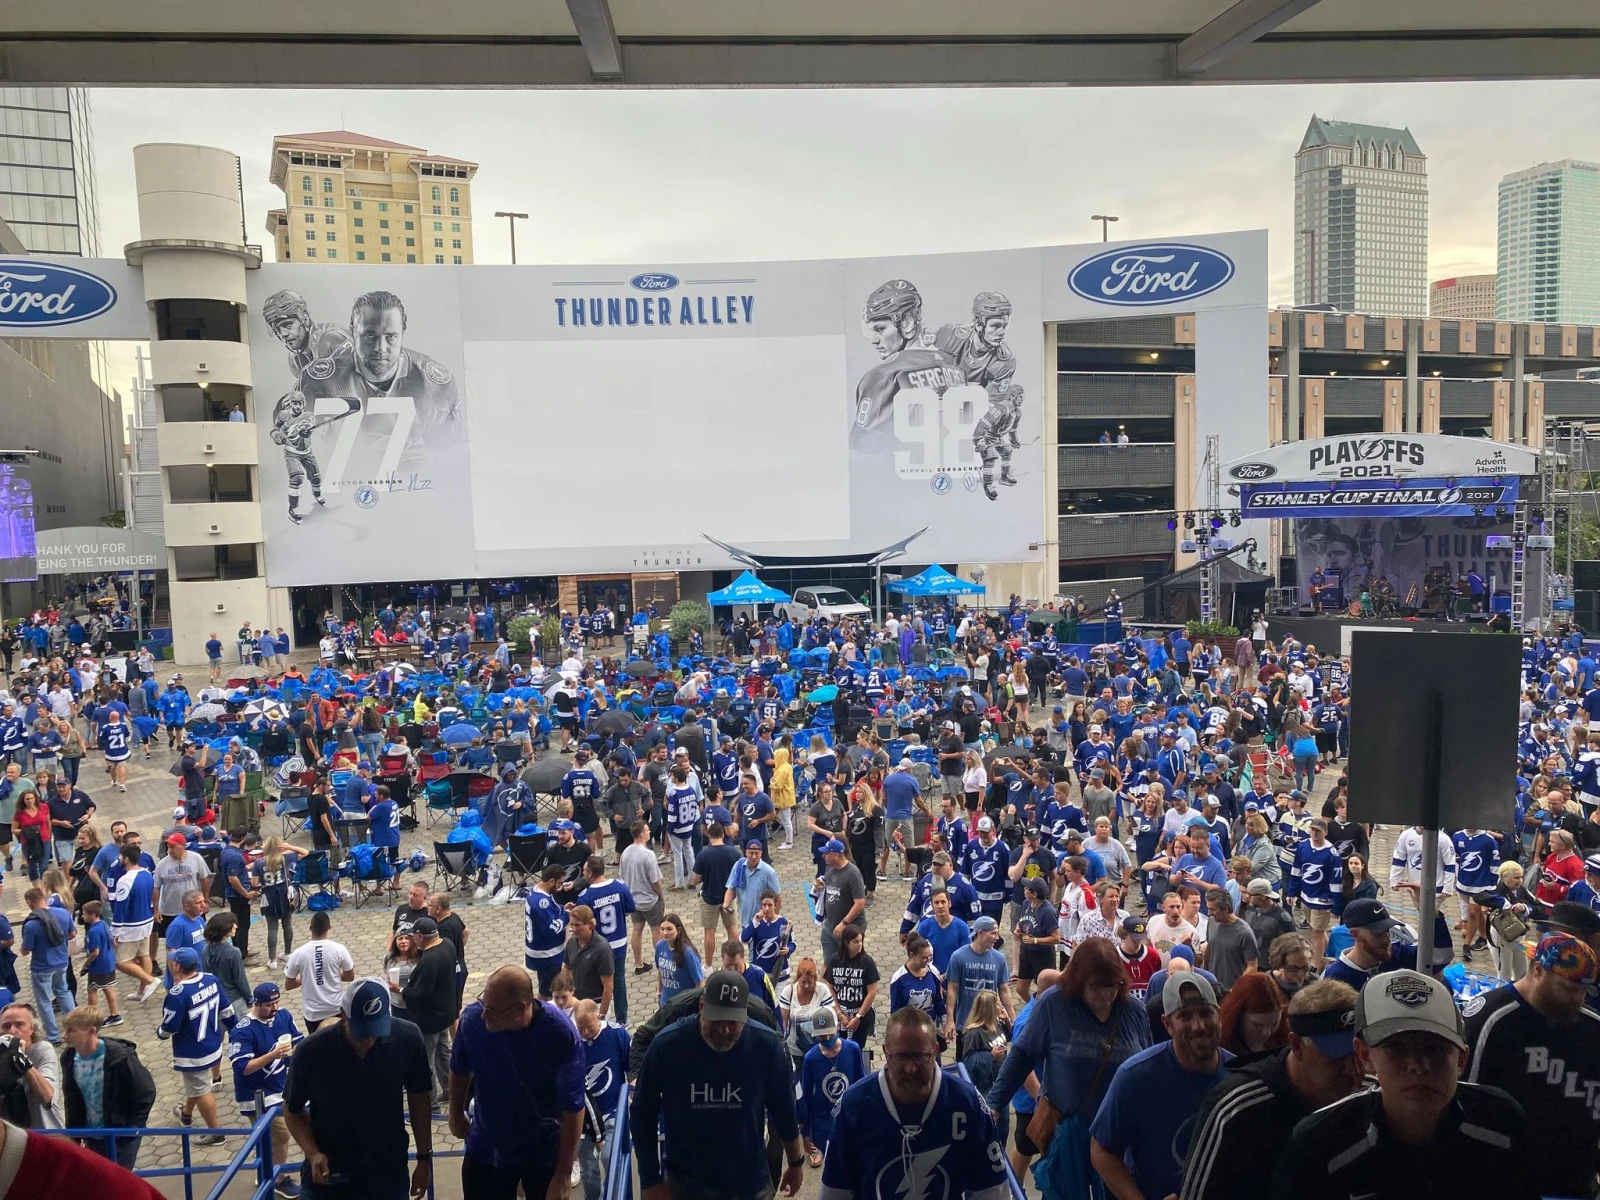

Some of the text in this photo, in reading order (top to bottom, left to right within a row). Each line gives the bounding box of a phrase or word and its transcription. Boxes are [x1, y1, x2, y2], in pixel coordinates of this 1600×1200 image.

[640, 275, 670, 289] Ford
[1101, 254, 1197, 296] Ford
[555, 295, 755, 328] THUNDER ALLEY
[893, 385, 990, 480] 98
[313, 397, 415, 493] 77
[1475, 458, 1506, 466] Advent
[1238, 465, 1267, 477] Ford
[1340, 465, 1393, 477] 2021
[1253, 492, 1328, 507] STANLEY
[1331, 491, 1371, 505] CUP
[1372, 489, 1437, 505] FINAL
[75, 543, 100, 555] YOU
[103, 542, 126, 553] FOR
[70, 557, 94, 568] THE
[96, 554, 157, 567] THUNDER!
[633, 557, 702, 567] THUNDER
[592, 621, 602, 630] 91
[868, 674, 881, 687] 21
[933, 687, 943, 696] 91
[107, 733, 125, 750] 21
[1049, 752, 1058, 760] 71
[678, 802, 698, 824] 86
[993, 851, 999, 861] C
[593, 893, 620, 910] JOHNSON
[599, 904, 617, 935] 9
[315, 945, 325, 987] LIGHTNING
[832, 967, 845, 977] YOU
[965, 962, 984, 970] TAMPA
[191, 982, 218, 1005] HEDMAN
[719, 984, 739, 1003] PC
[1386, 985, 1433, 994] CHAMPIONS
[188, 993, 220, 1042] 77
[690, 1082, 743, 1103] Huk
[952, 1112, 967, 1140] C
[987, 1141, 1006, 1173] 9
